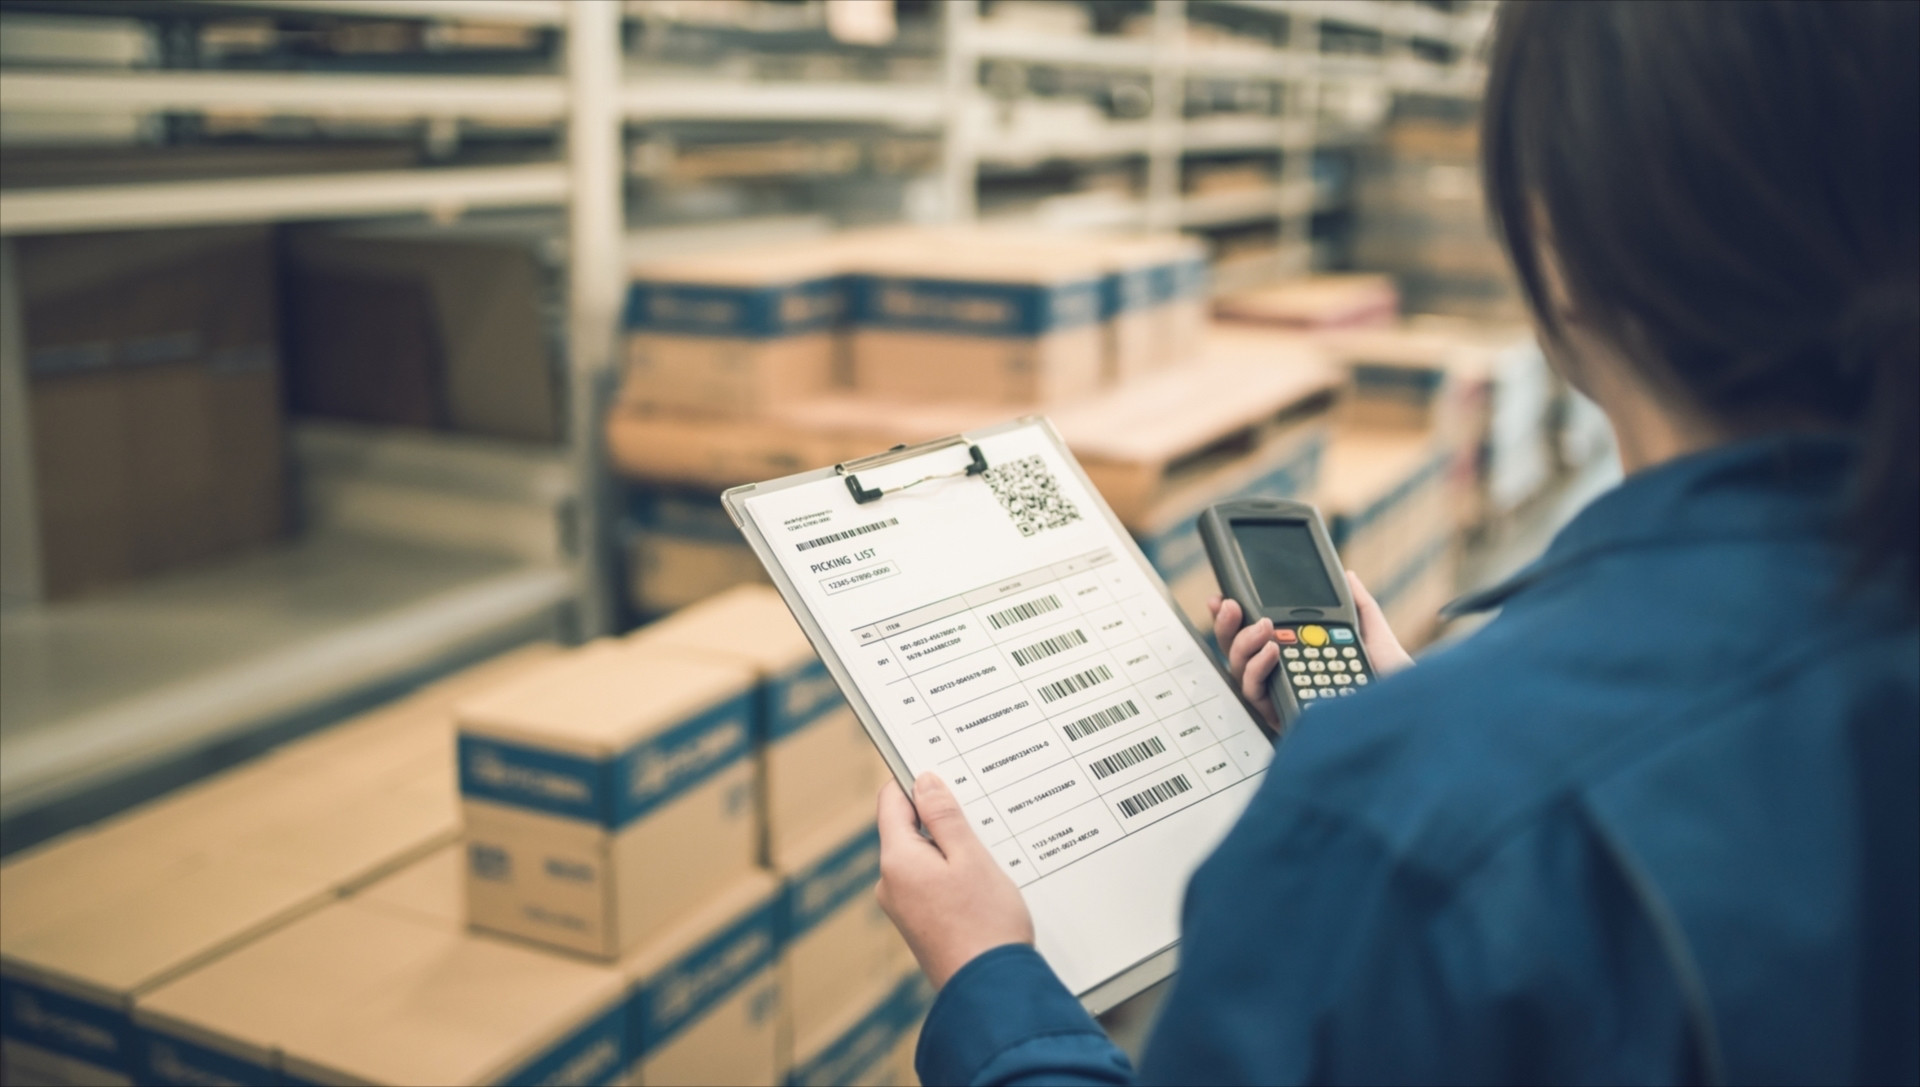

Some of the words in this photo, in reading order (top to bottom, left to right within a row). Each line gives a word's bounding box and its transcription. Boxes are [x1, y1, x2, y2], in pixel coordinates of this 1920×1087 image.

[810, 555, 851, 573] PICKING
[854, 548, 876, 561] LIST
[829, 566, 891, 590] 12345-67890-0000
[886, 622, 901, 632] ITEM
[878, 658, 889, 666] 001
[903, 697, 915, 705] 002
[929, 736, 941, 744] 003
